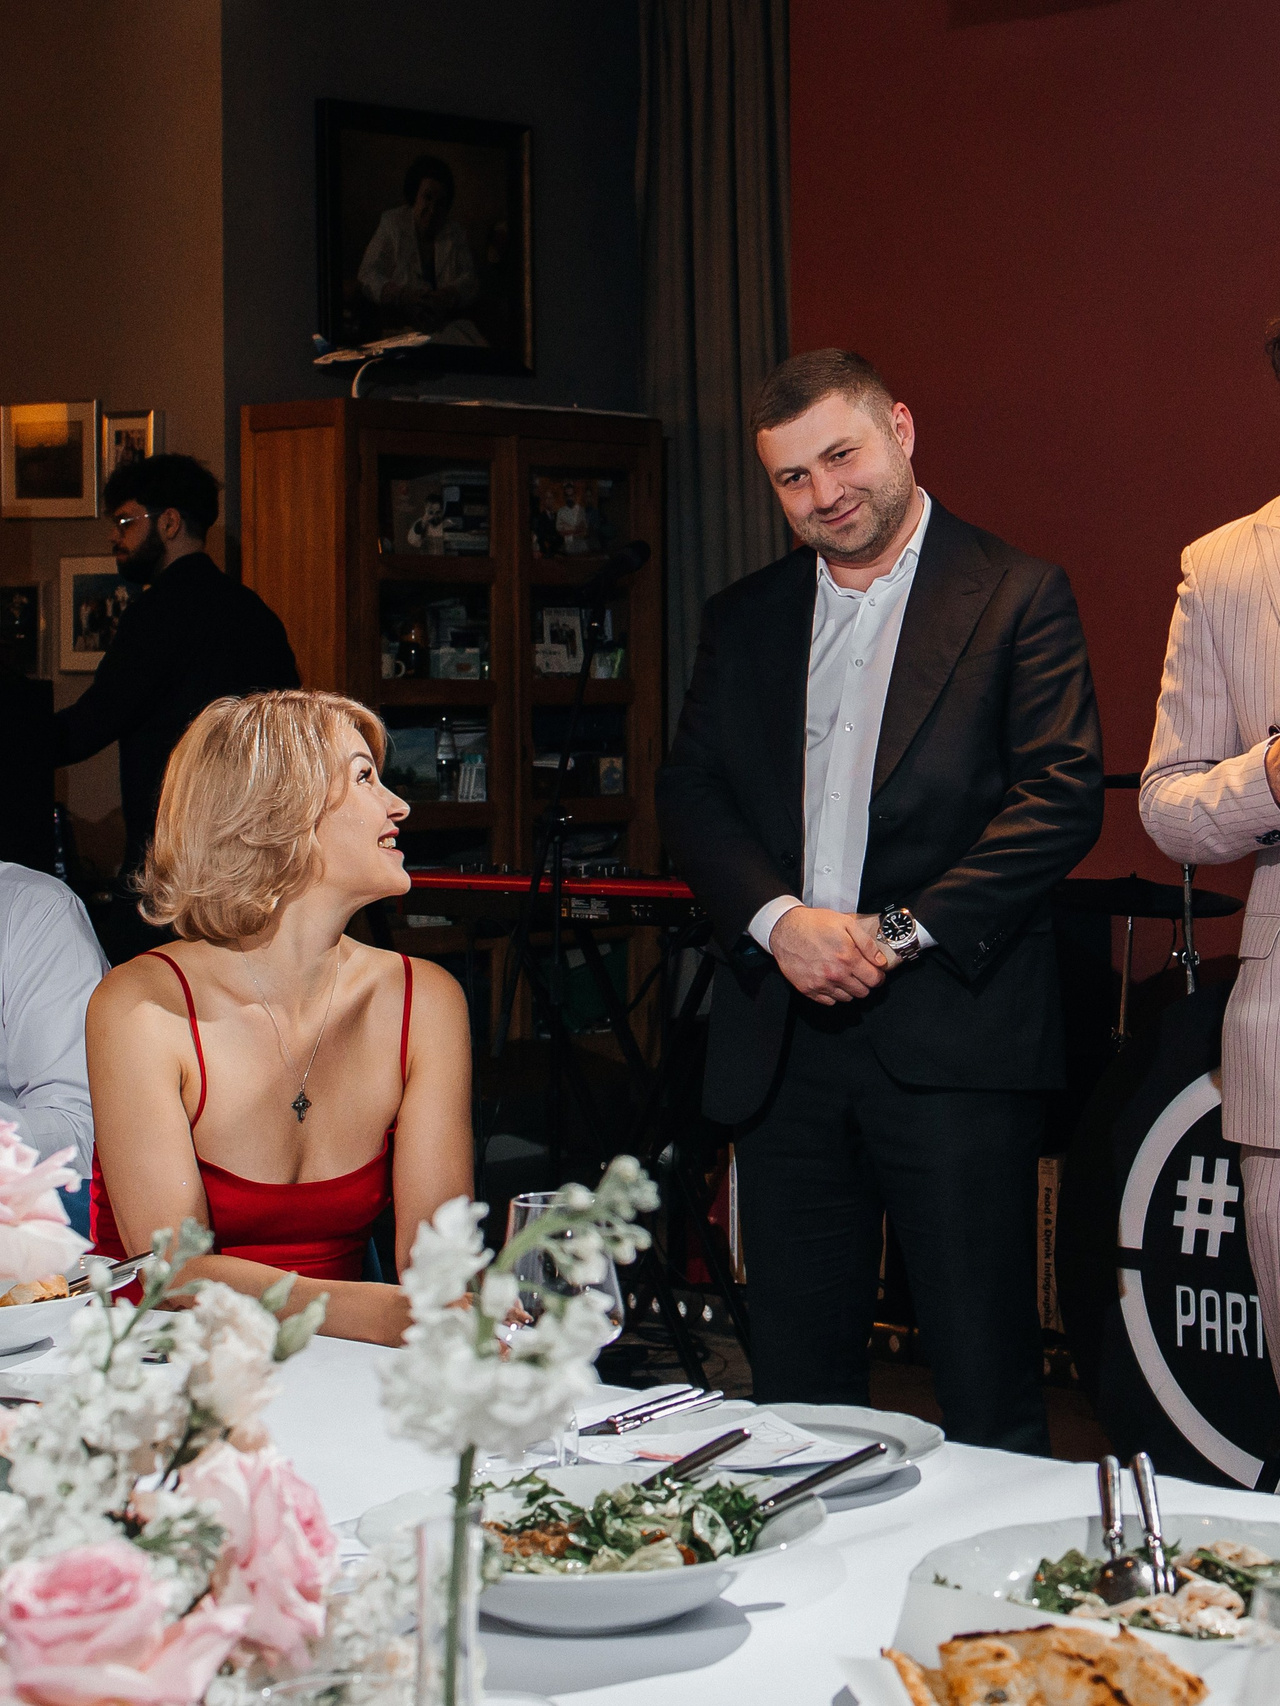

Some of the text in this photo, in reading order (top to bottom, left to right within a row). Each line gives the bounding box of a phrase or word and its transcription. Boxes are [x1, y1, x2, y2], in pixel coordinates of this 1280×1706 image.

[1044, 1187, 1053, 1214] Food
[1173, 1155, 1239, 1258] #
[1044, 1218, 1053, 1226] &
[1044, 1229, 1053, 1259] Drink
